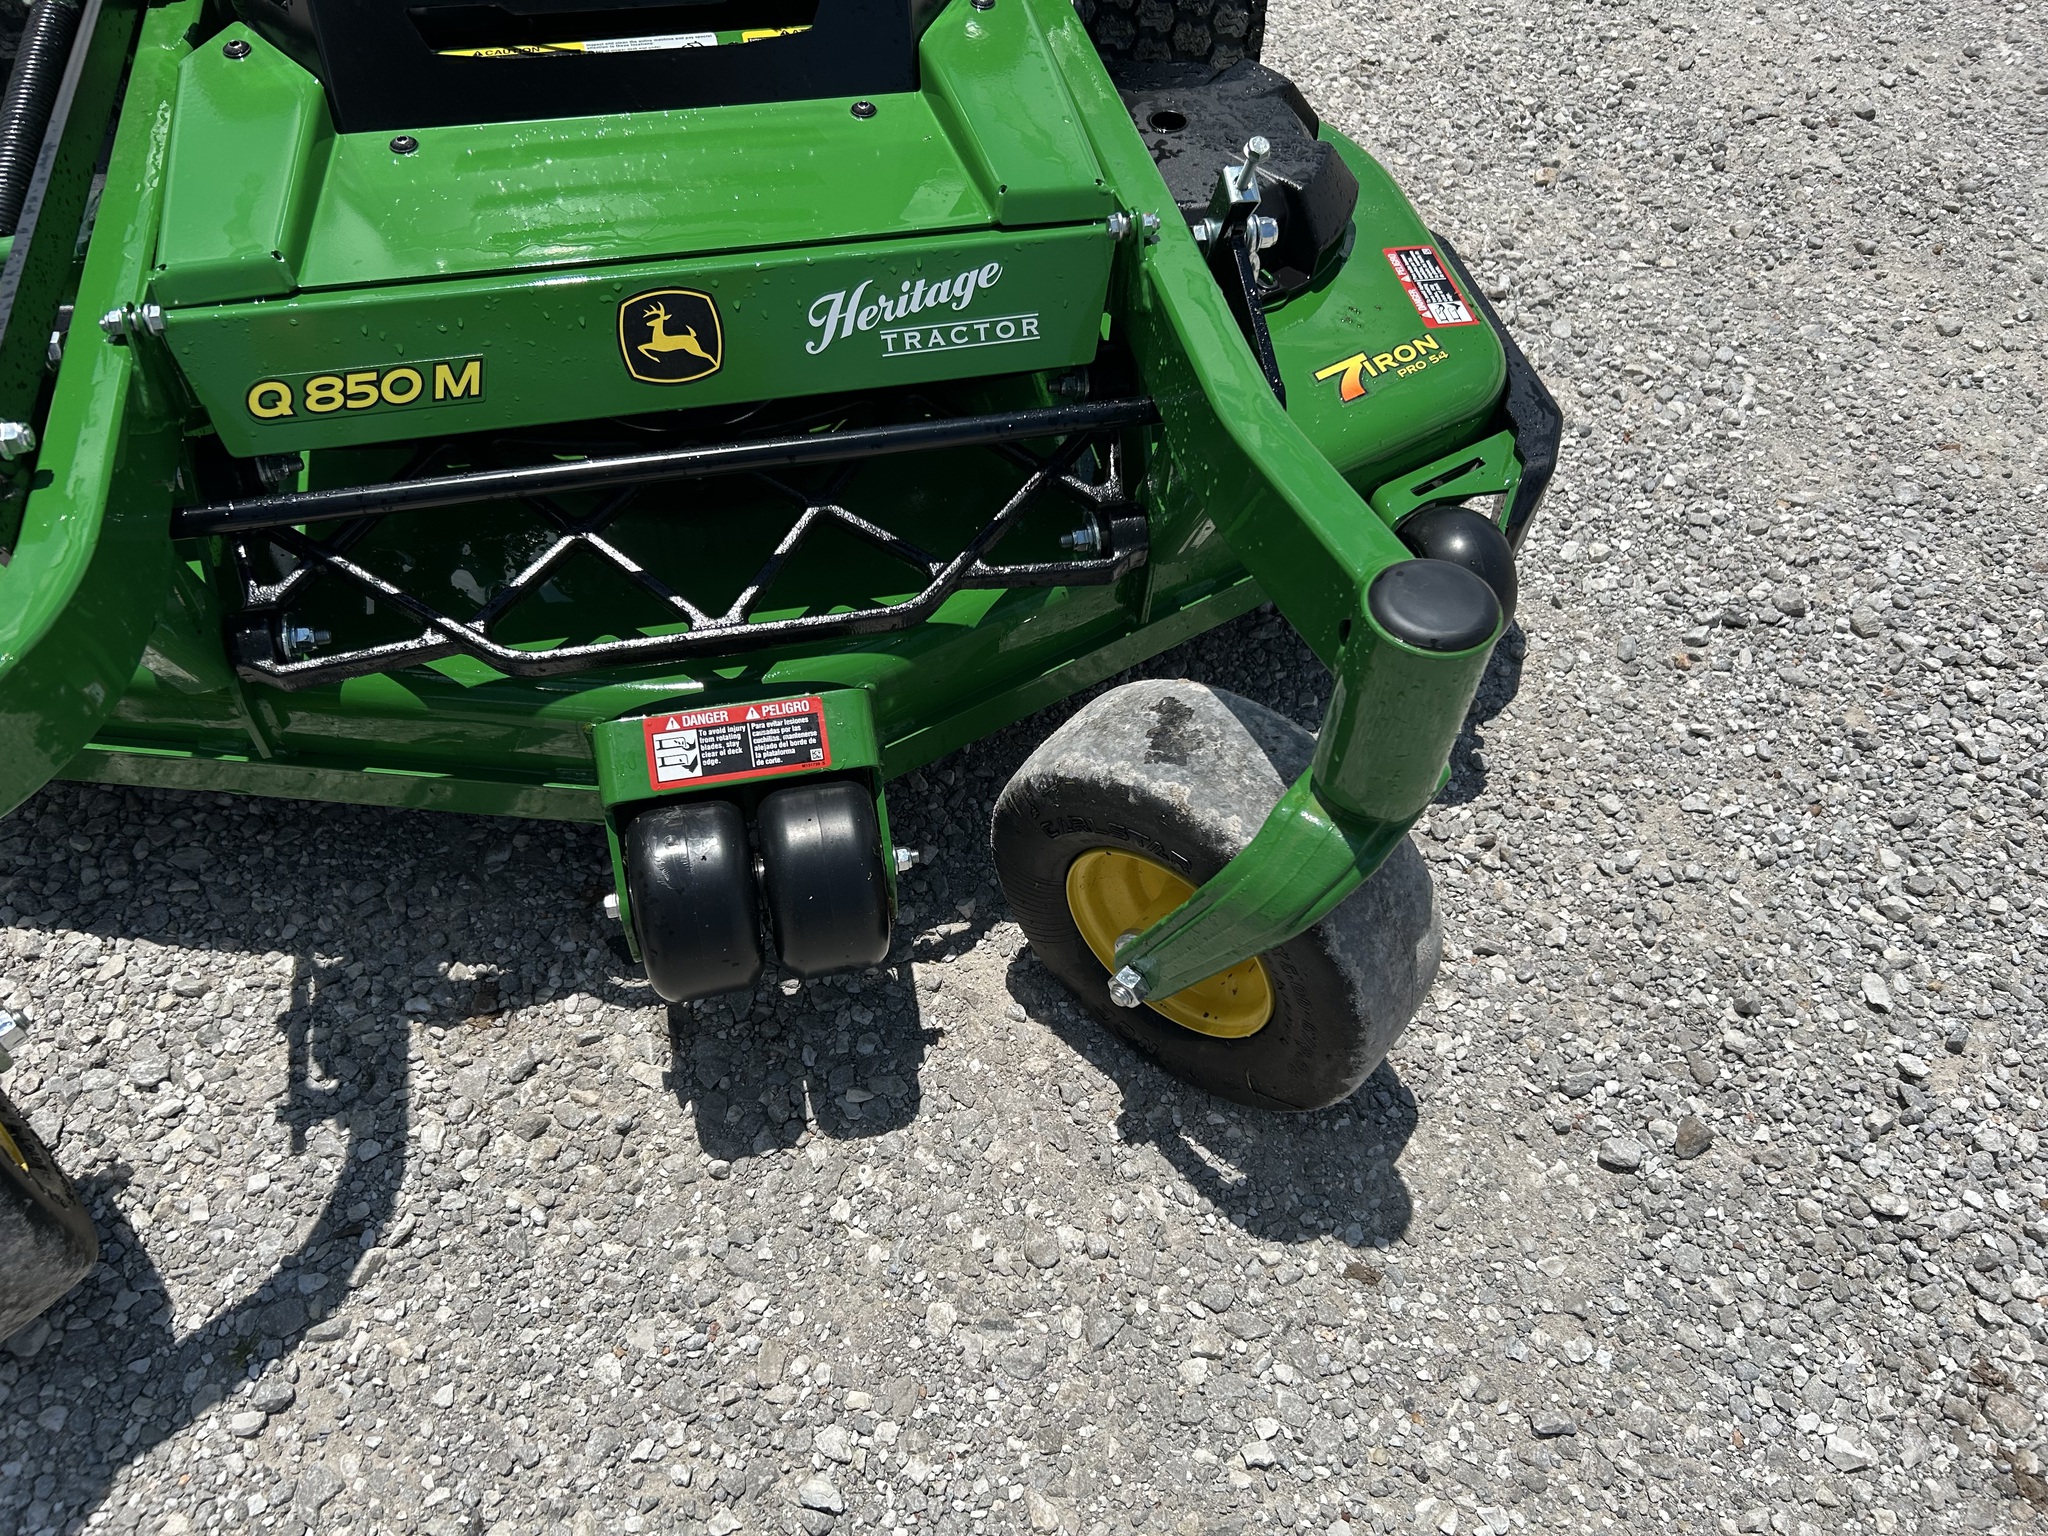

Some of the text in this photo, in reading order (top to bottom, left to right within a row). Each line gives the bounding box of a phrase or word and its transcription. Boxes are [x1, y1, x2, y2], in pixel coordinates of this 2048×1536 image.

[486, 46, 540, 56] CAUTION
[1387, 253, 1407, 276] PELIGRO
[1408, 289, 1427, 311] DANGER
[804, 261, 1003, 355] Heritage
[880, 317, 1040, 352] TRACTOR
[1397, 350, 1449, 378] PRO 54
[247, 360, 482, 419] Q 850 M
[761, 700, 810, 717] PELIGRO
[682, 711, 729, 727] DANGER
[751, 717, 809, 730] Para evitar lesiones
[708, 726, 726, 735] avoid
[727, 725, 746, 733] injury
[752, 728, 780, 737] causadas
[781, 726, 791, 734] por
[782, 731, 817, 740] mantenerse
[716, 733, 741, 742] rotating
[700, 740, 740, 751] blades, stay
[754, 743, 777, 752] alejado
[789, 739, 807, 747] borde
[701, 750, 718, 758] clear
[762, 748, 796, 758] plataforma
[702, 758, 721, 767] edge.
[765, 757, 783, 765] corte.
[1039, 815, 1192, 875] CARLSTAR
